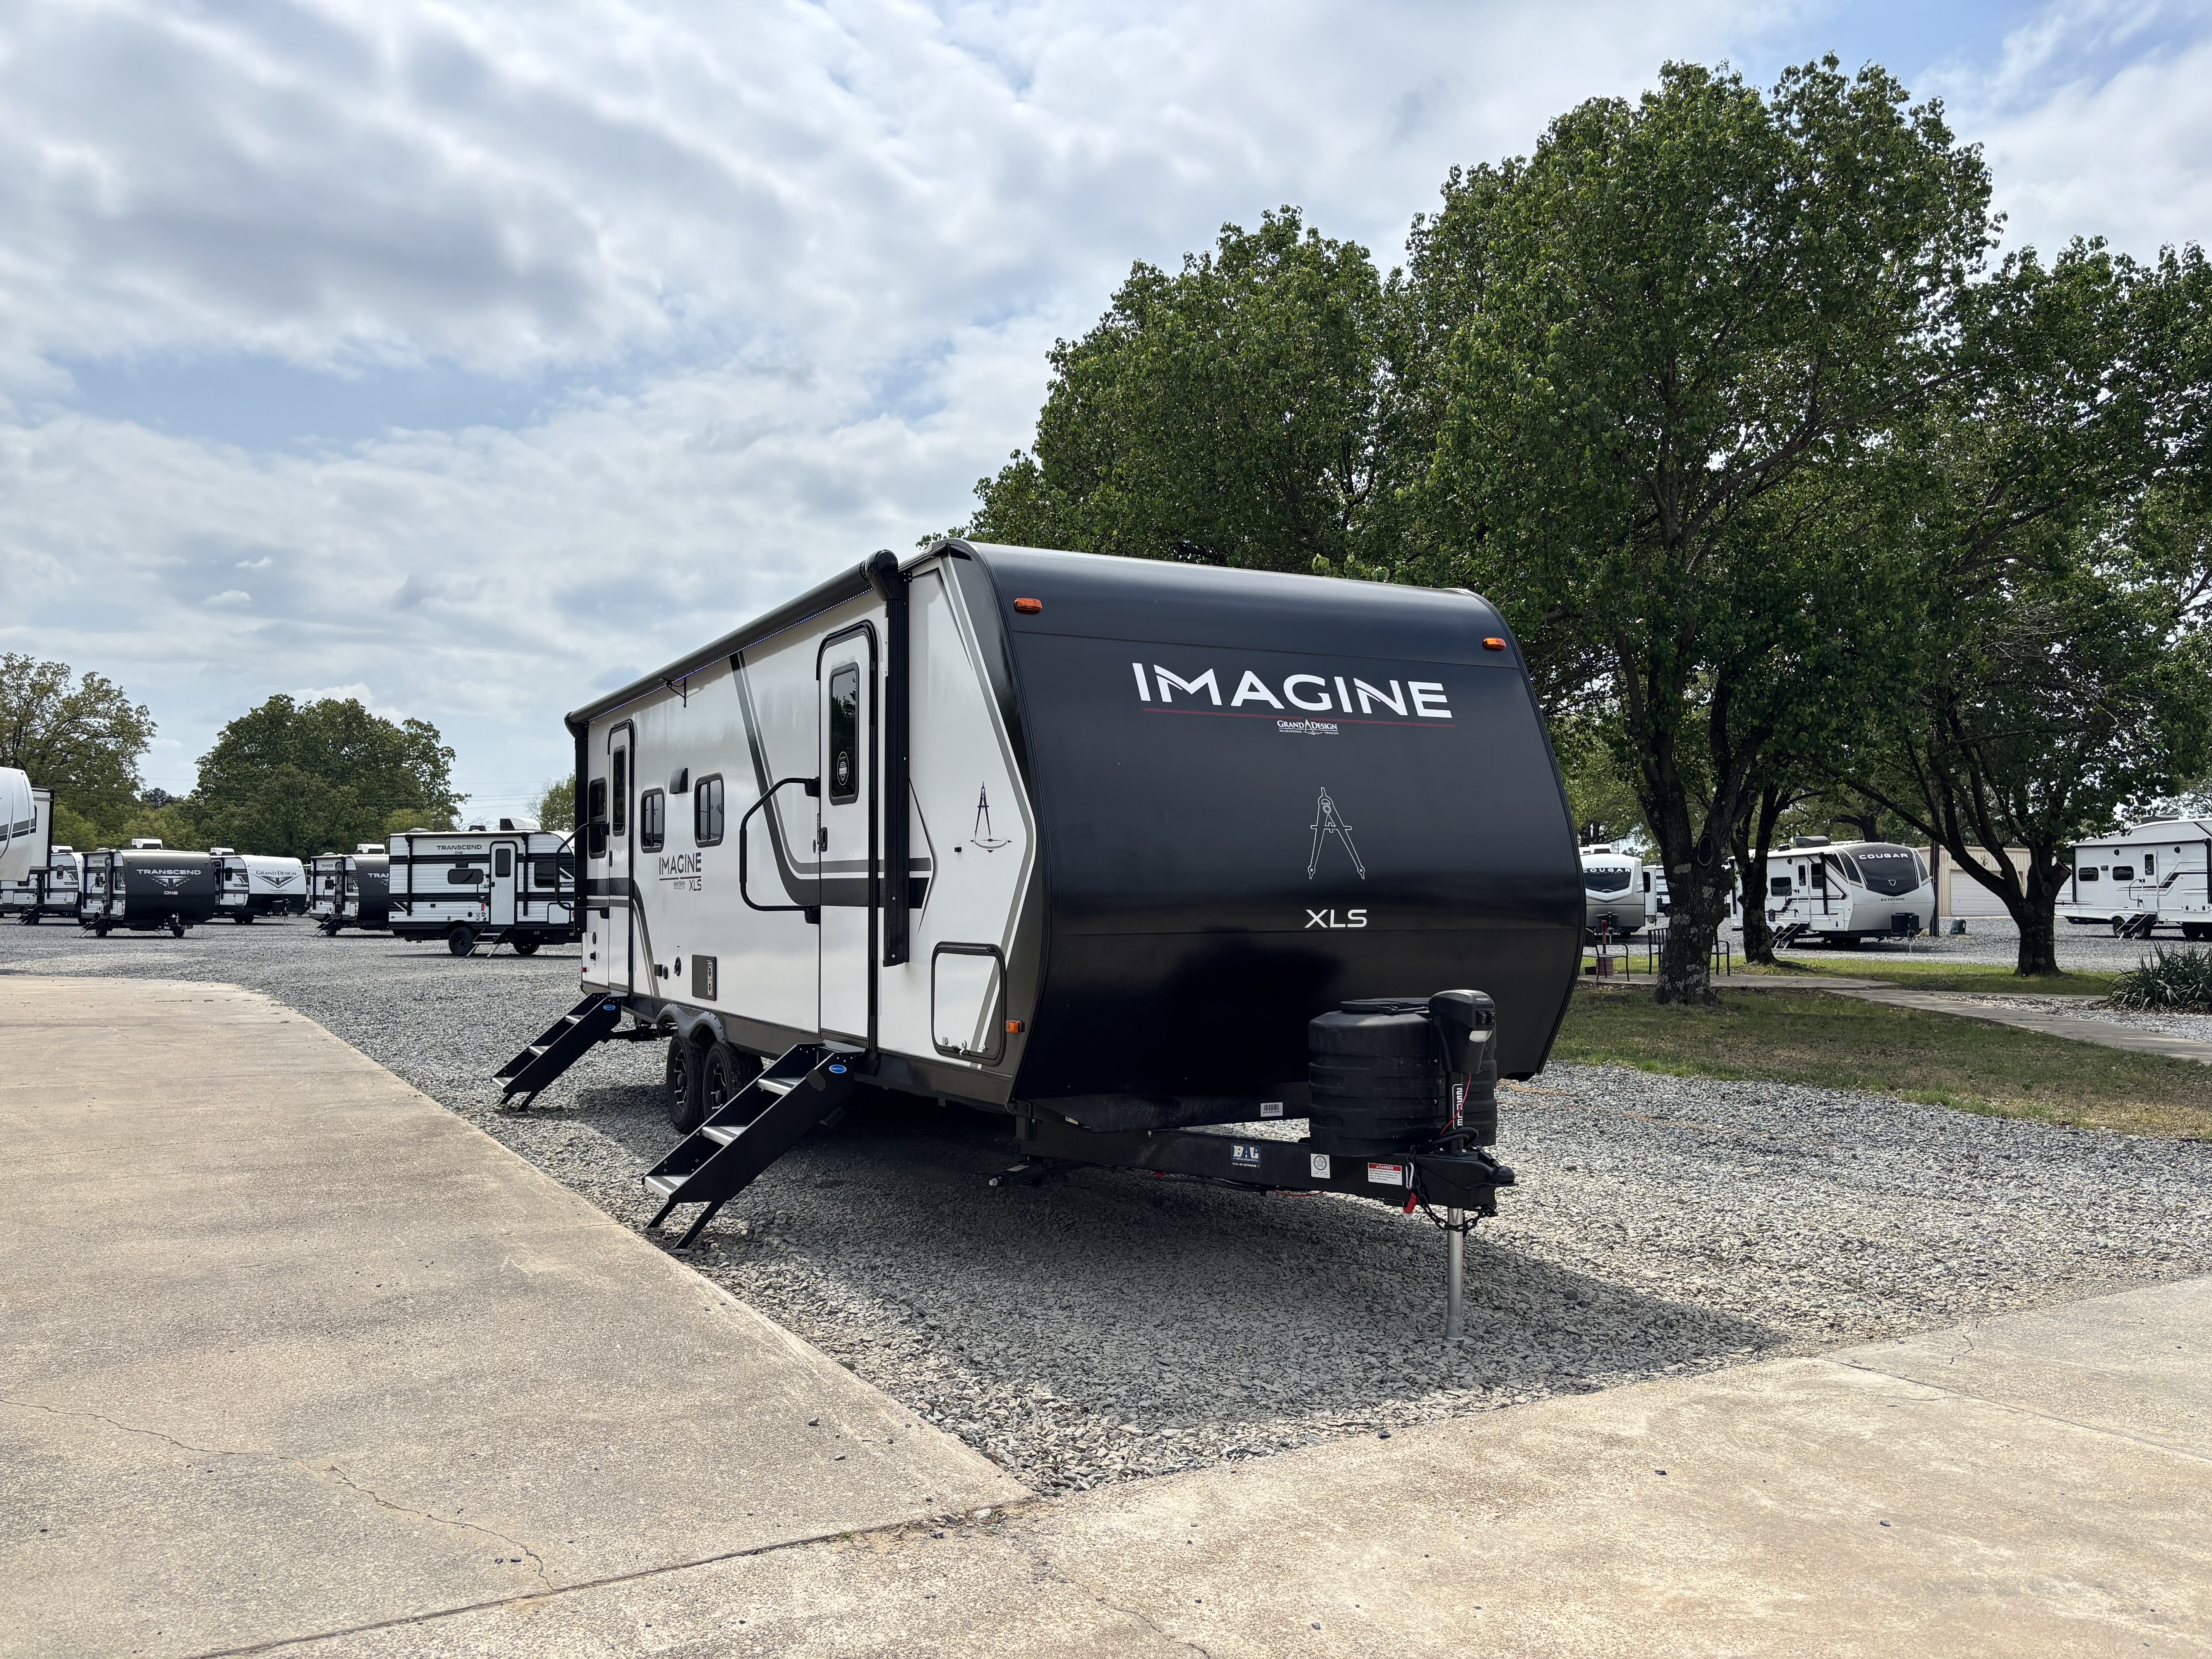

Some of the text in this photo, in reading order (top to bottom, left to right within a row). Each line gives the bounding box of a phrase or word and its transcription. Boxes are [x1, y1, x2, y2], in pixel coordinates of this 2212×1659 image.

[1132, 663, 1453, 718] IMAGINE
[1277, 720, 1338, 730] GRAND DESIGN
[659, 852, 701, 875] IMAGINE
[689, 879, 702, 891] XLS
[1304, 909, 1367, 928] XLS
